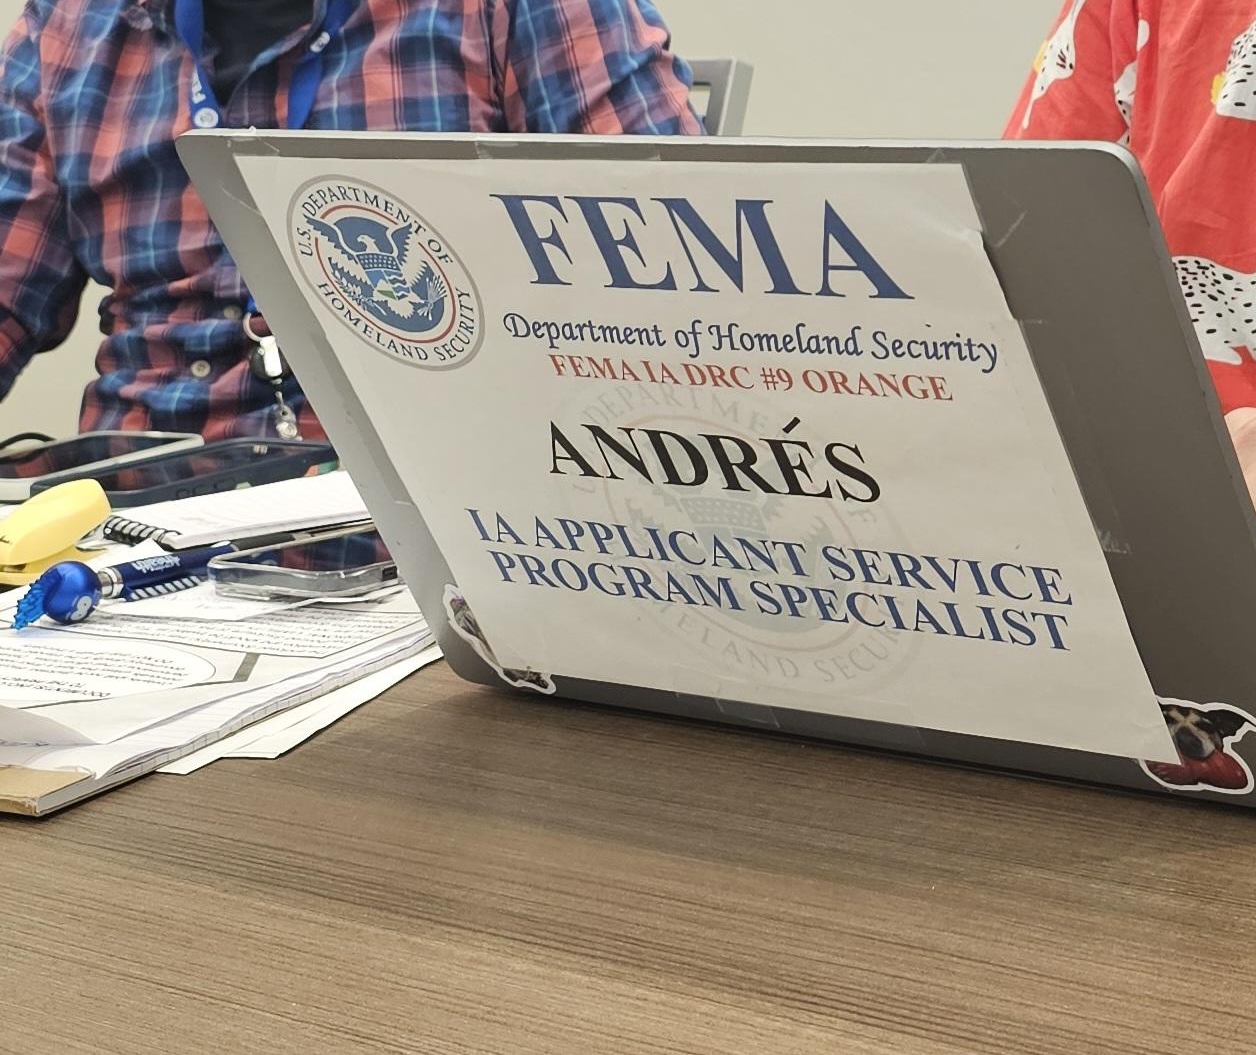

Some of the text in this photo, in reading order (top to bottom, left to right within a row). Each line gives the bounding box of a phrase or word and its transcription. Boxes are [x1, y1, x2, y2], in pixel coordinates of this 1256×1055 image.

[297, 185, 453, 264] U.S. DEPARTMENT OF
[489, 193, 915, 299] FEMA
[318, 283, 474, 361] HOMELAND SECURITY
[503, 313, 997, 373] Department of Homeland Security
[548, 354, 953, 400] FEMA IA DRC #9 ORANGE
[550, 417, 881, 503] ANDRÉS
[464, 508, 1072, 605] IA APPLICANT SERVICE
[487, 549, 1071, 650] PROGRAM SPECIALIST
